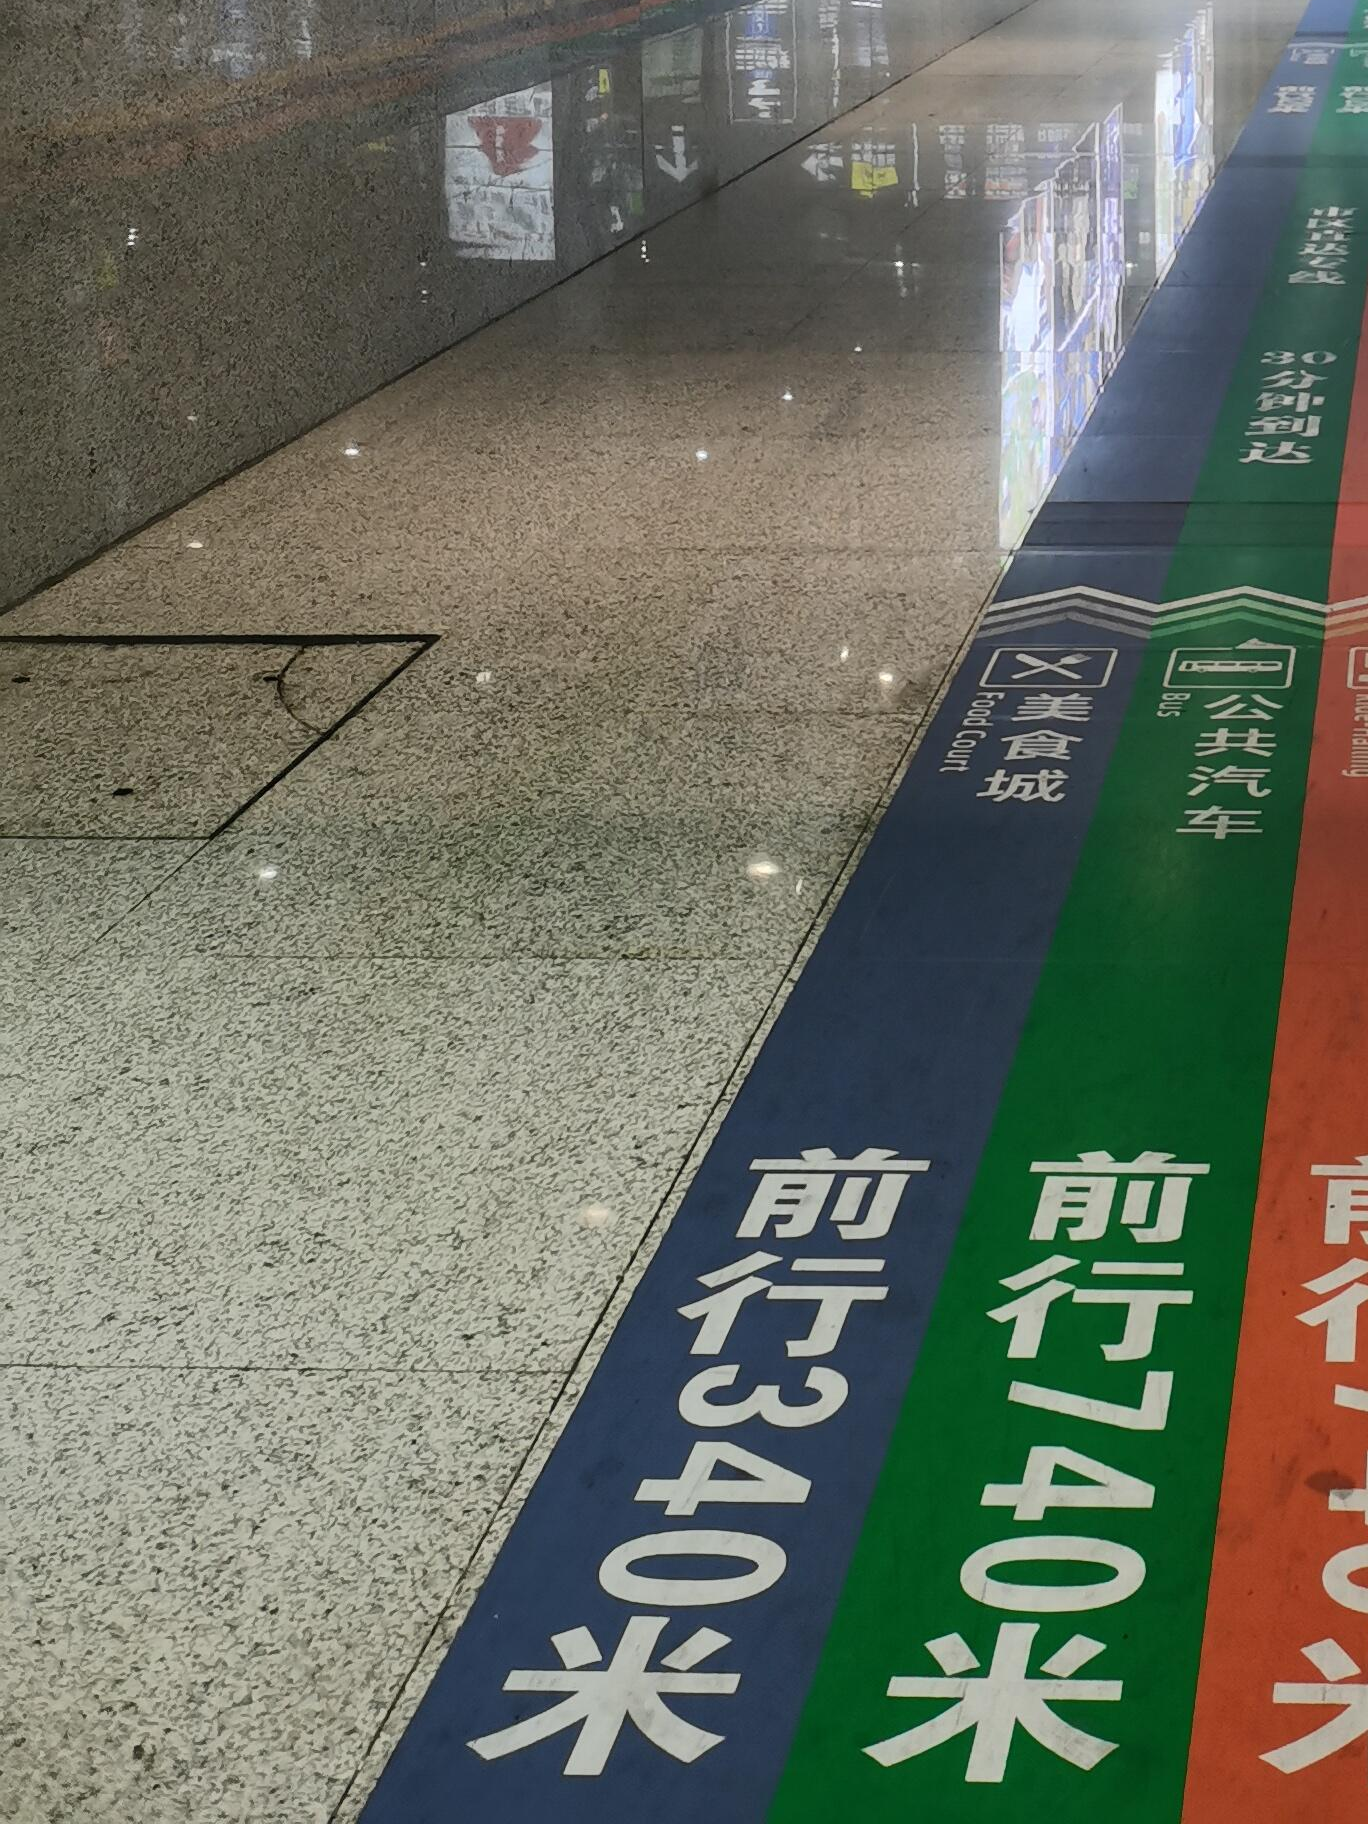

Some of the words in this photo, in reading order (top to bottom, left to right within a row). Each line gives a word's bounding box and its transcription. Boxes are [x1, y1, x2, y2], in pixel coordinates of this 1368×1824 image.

[1239, 350, 1338, 465] 30分钟到达
[939, 728, 988, 773] Court
[960, 691, 1005, 728] Food
[976, 692, 1094, 803] 美食城
[1157, 692, 1191, 719] Bus
[1175, 693, 1284, 840] 公共汽车
[465, 1147, 931, 1775] 前行340米
[861, 1150, 1211, 1782] 前行740米
